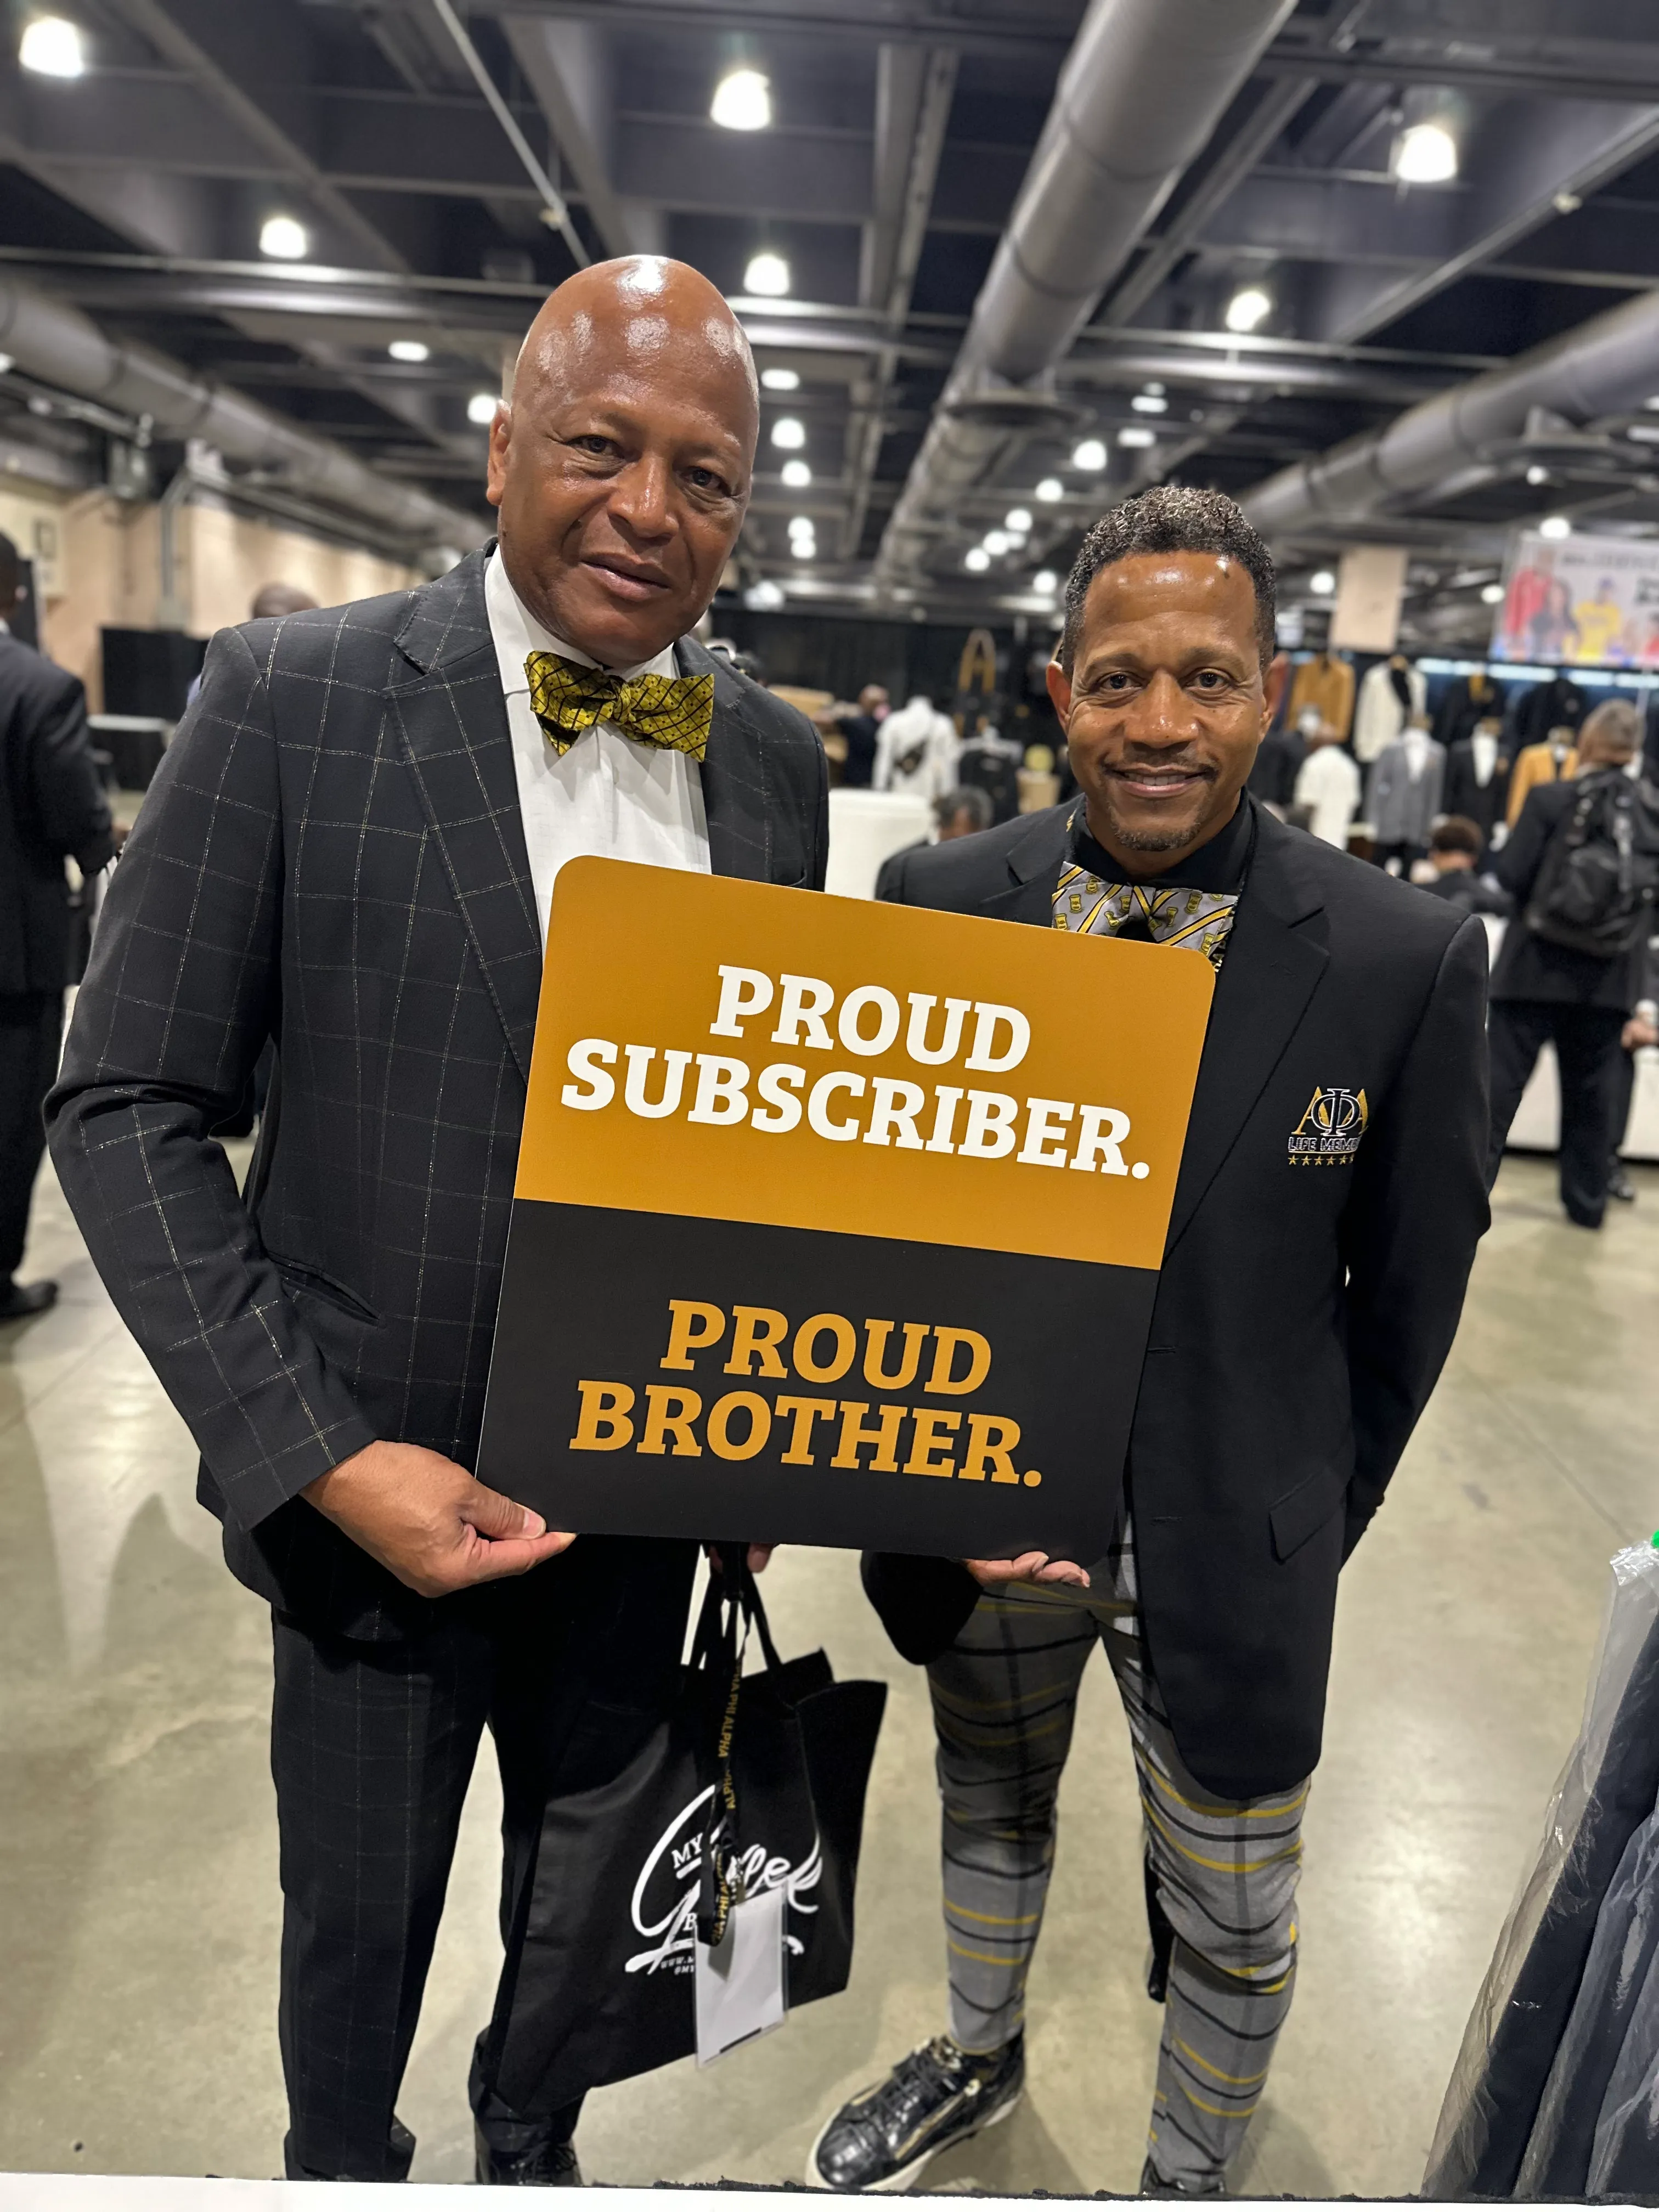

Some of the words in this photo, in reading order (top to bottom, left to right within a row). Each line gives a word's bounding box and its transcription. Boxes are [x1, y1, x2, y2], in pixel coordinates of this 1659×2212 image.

[709, 964, 1031, 1073] PROUD
[561, 1038, 1150, 1180] SUBSCRIBER.
[1288, 1136, 1317, 1151] LIFE
[659, 1299, 991, 1396] PROUD
[569, 1379, 1042, 1488] BROTHER.
[718, 1714, 735, 1758] ALPHA
[726, 1693, 738, 1714] PHI
[670, 1832, 703, 1870] MY
